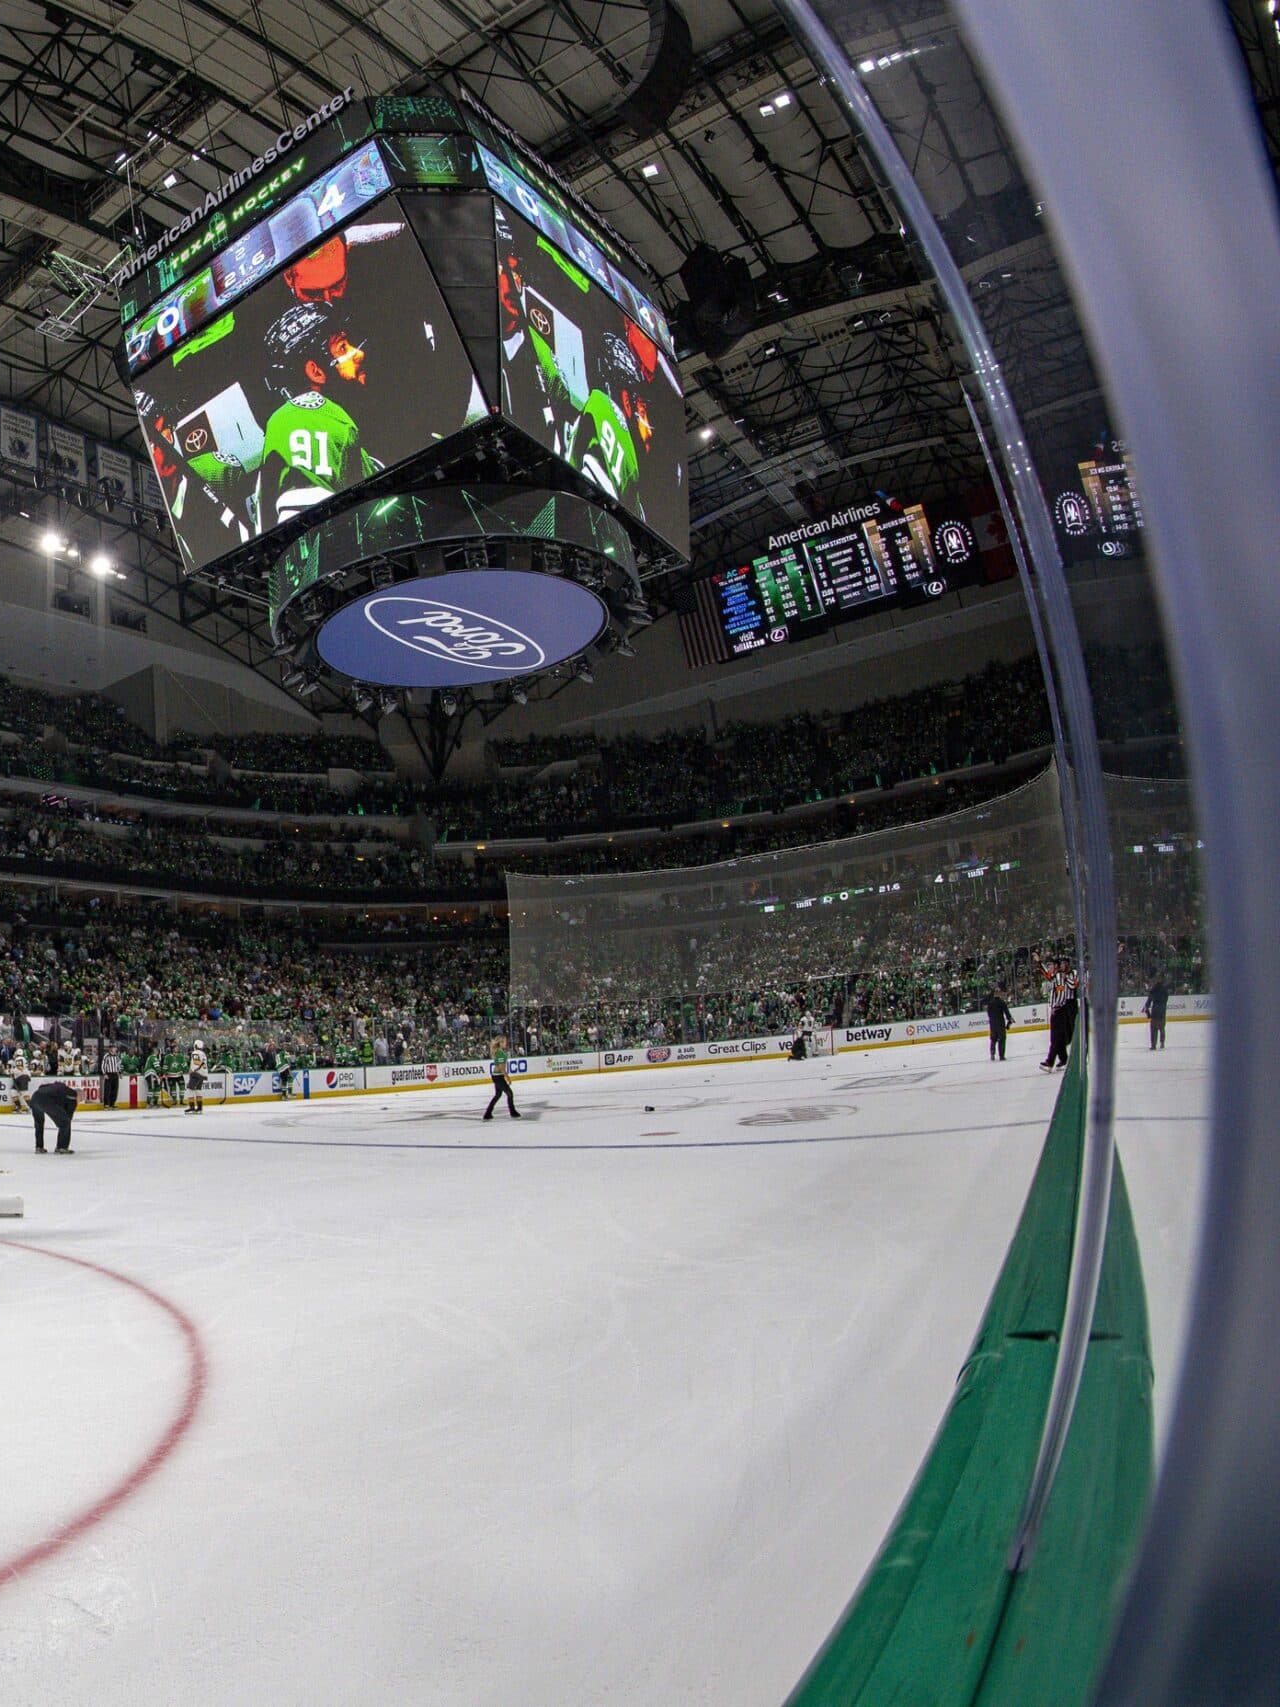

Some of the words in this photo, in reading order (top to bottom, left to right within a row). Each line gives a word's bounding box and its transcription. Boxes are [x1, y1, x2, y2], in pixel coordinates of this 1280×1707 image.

[170, 221, 228, 269] TEXAS
[232, 156, 307, 220] HOCKEY
[317, 184, 347, 216] 4
[224, 250, 265, 288] 21.6
[157, 306, 180, 336] 0
[288, 429, 332, 476] 91
[599, 419, 625, 486] 91
[768, 518, 830, 550] American
[830, 502, 881, 529] Airlines
[396, 609, 527, 661] Ford
[738, 631, 756, 642] visit
[846, 1027, 893, 1042] betway
[916, 1024, 936, 1034] PNC
[936, 1020, 961, 1032] BANK
[707, 1044, 739, 1055] Great
[741, 1041, 767, 1053] Clips
[233, 1078, 257, 1092] SAP
[391, 1065, 425, 1085] guaranteed
[451, 1065, 486, 1077] HONDA
